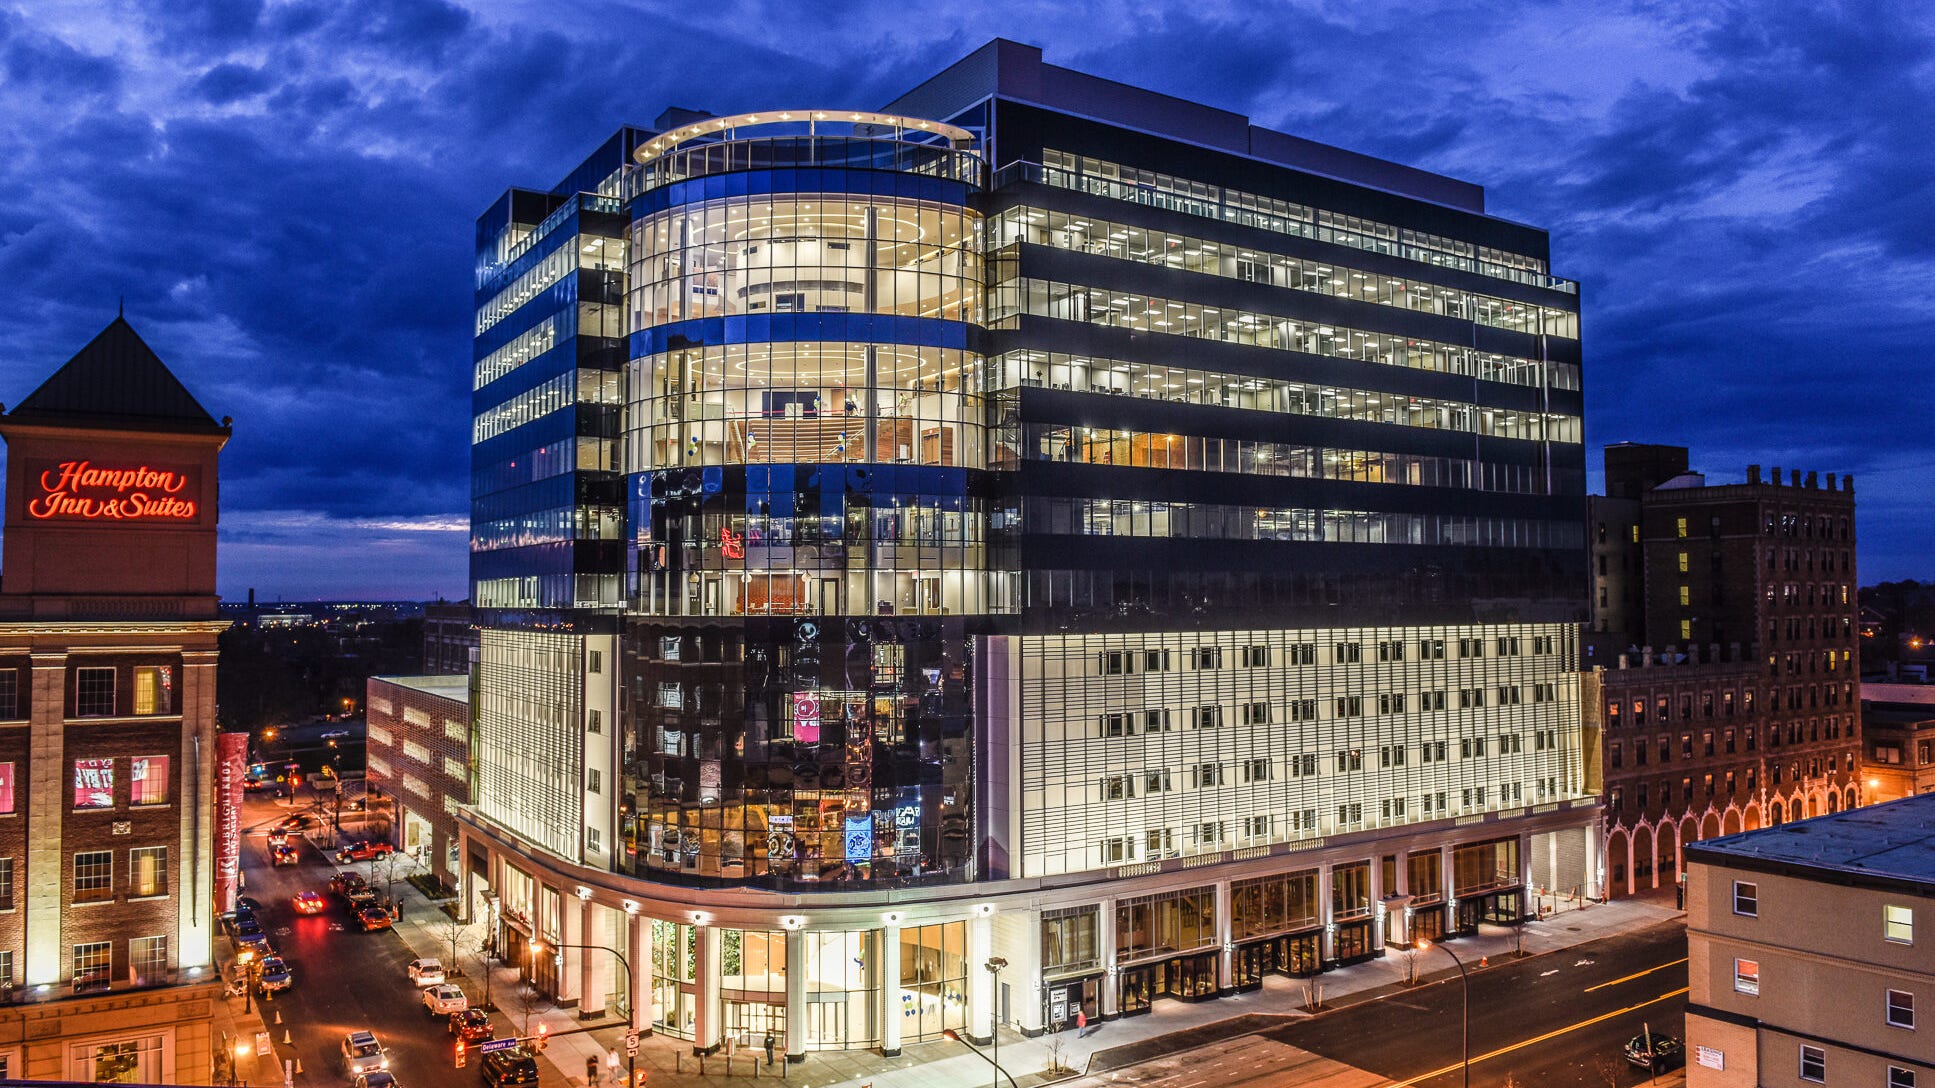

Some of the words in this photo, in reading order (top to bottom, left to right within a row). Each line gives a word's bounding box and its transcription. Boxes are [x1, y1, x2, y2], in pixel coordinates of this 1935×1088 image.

[41, 461, 186, 493] Hampton
[29, 491, 104, 518] Inn
[119, 492, 197, 518] Suites
[482, 1042, 506, 1051] Delaware
